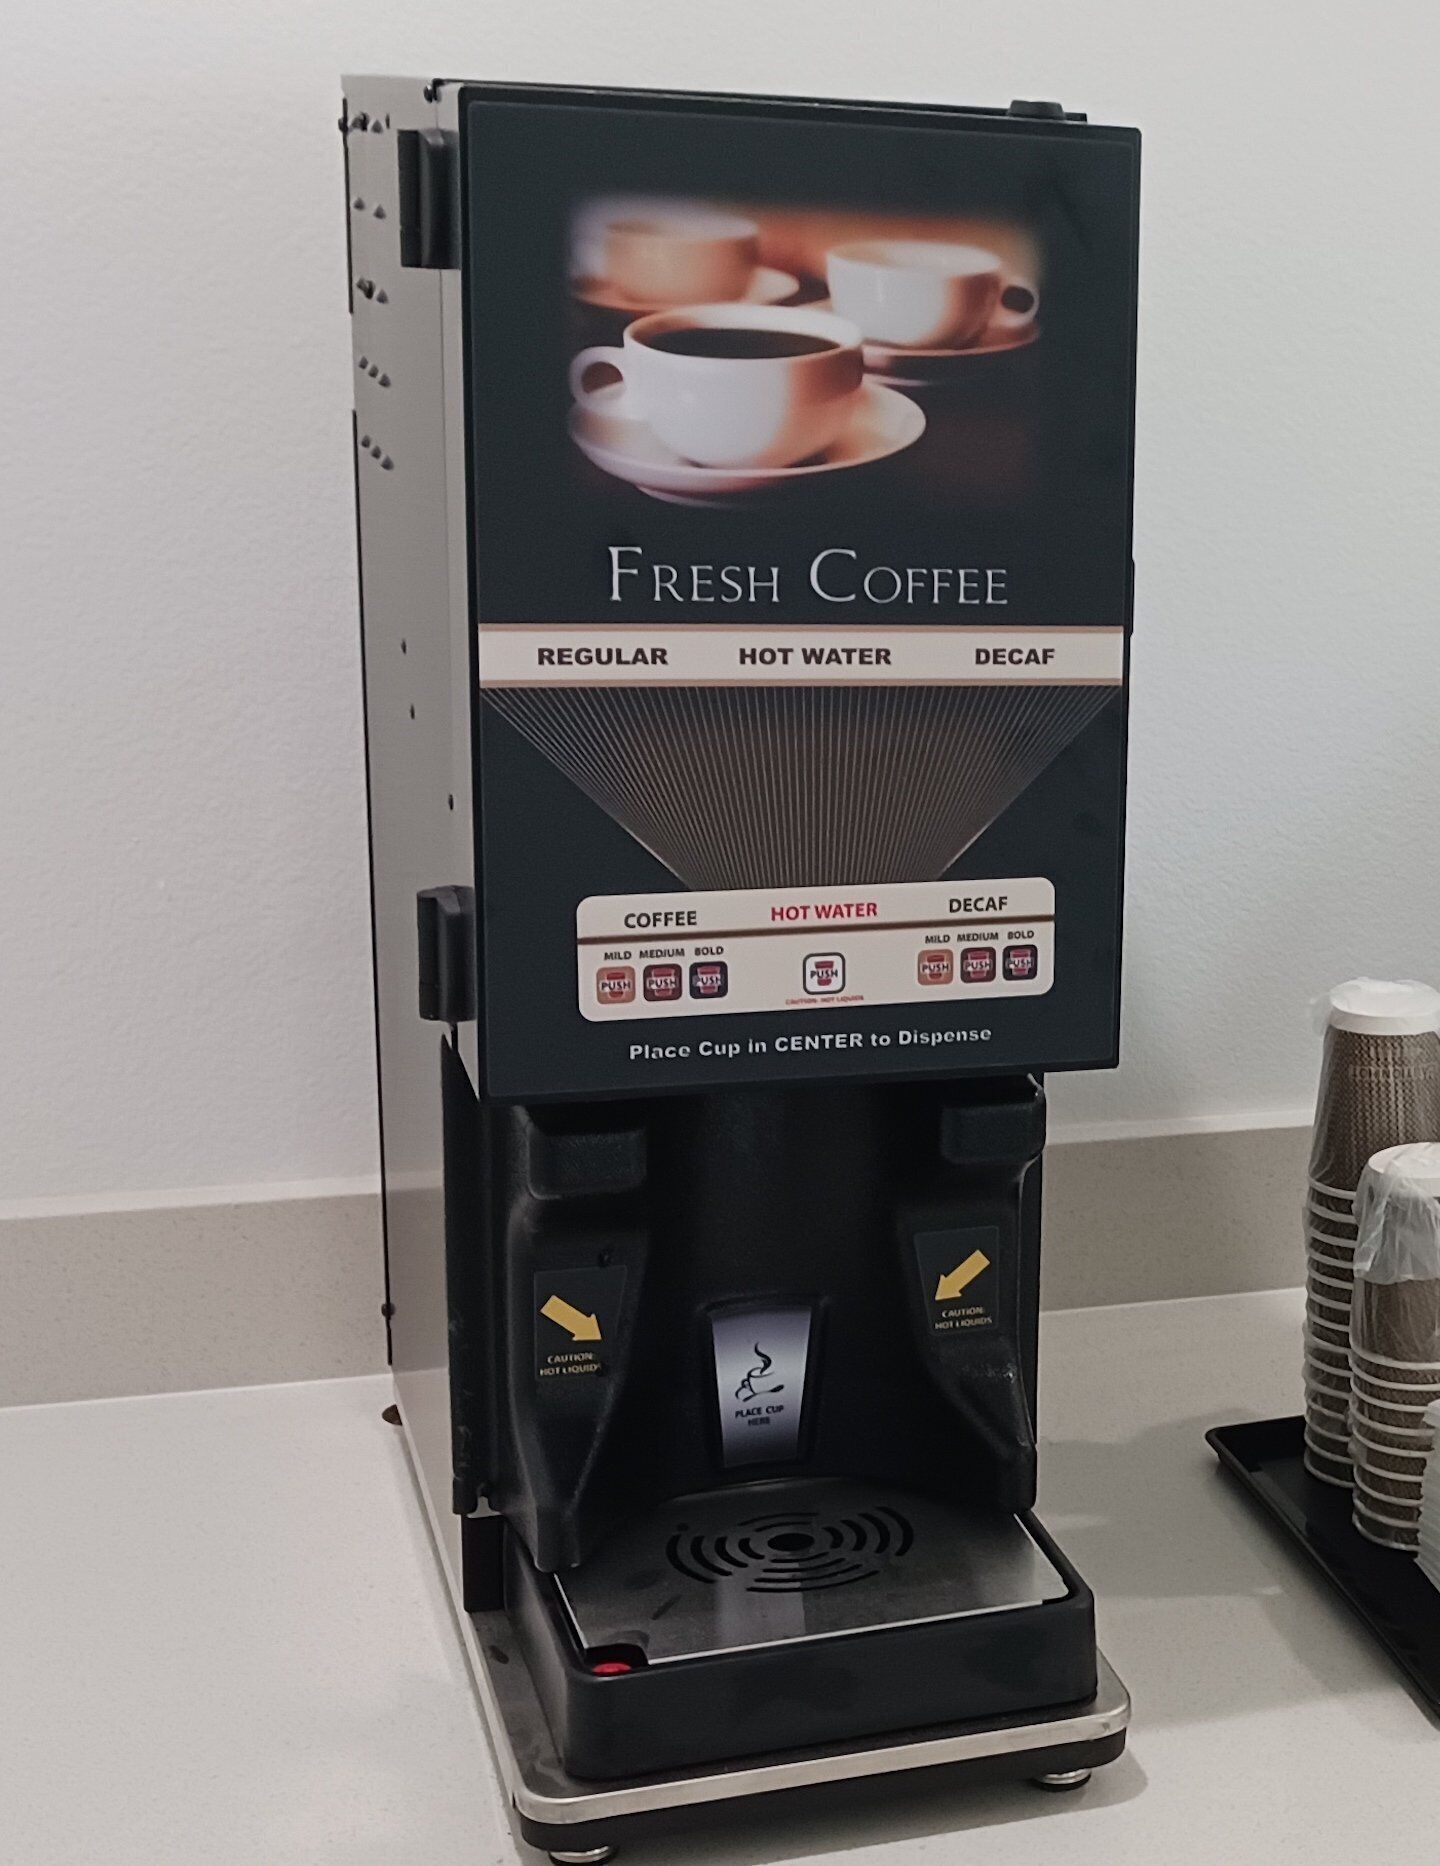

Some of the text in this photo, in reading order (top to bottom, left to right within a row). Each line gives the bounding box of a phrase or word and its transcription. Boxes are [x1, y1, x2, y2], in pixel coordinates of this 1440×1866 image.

[607, 545, 1008, 605] FRESH COFFEE
[537, 647, 668, 666] REGULAR
[739, 647, 892, 666] HOT WATER
[975, 647, 1055, 666] DECAF
[949, 896, 1008, 914] DECAF
[771, 902, 878, 922] HOT WATER
[624, 910, 697, 929] COFFEE
[925, 934, 950, 944] MILD
[957, 931, 999, 942] MEDIUM
[1007, 930, 1034, 940] BOLD
[604, 950, 632, 960] MILD
[639, 948, 685, 959] MEDIUM
[694, 946, 724, 956] BOLD
[922, 963, 949, 974] PUSH
[965, 960, 991, 971] PUSH
[810, 968, 838, 980] PUSH
[601, 980, 631, 991] PUSH
[648, 978, 678, 989] PUSH
[629, 1028, 992, 1060] Place Cup in CENTER to Dispense
[934, 1320, 953, 1330] HOT
[540, 1366, 560, 1376] HOT
[735, 1405, 784, 1418] PLACE CUP
